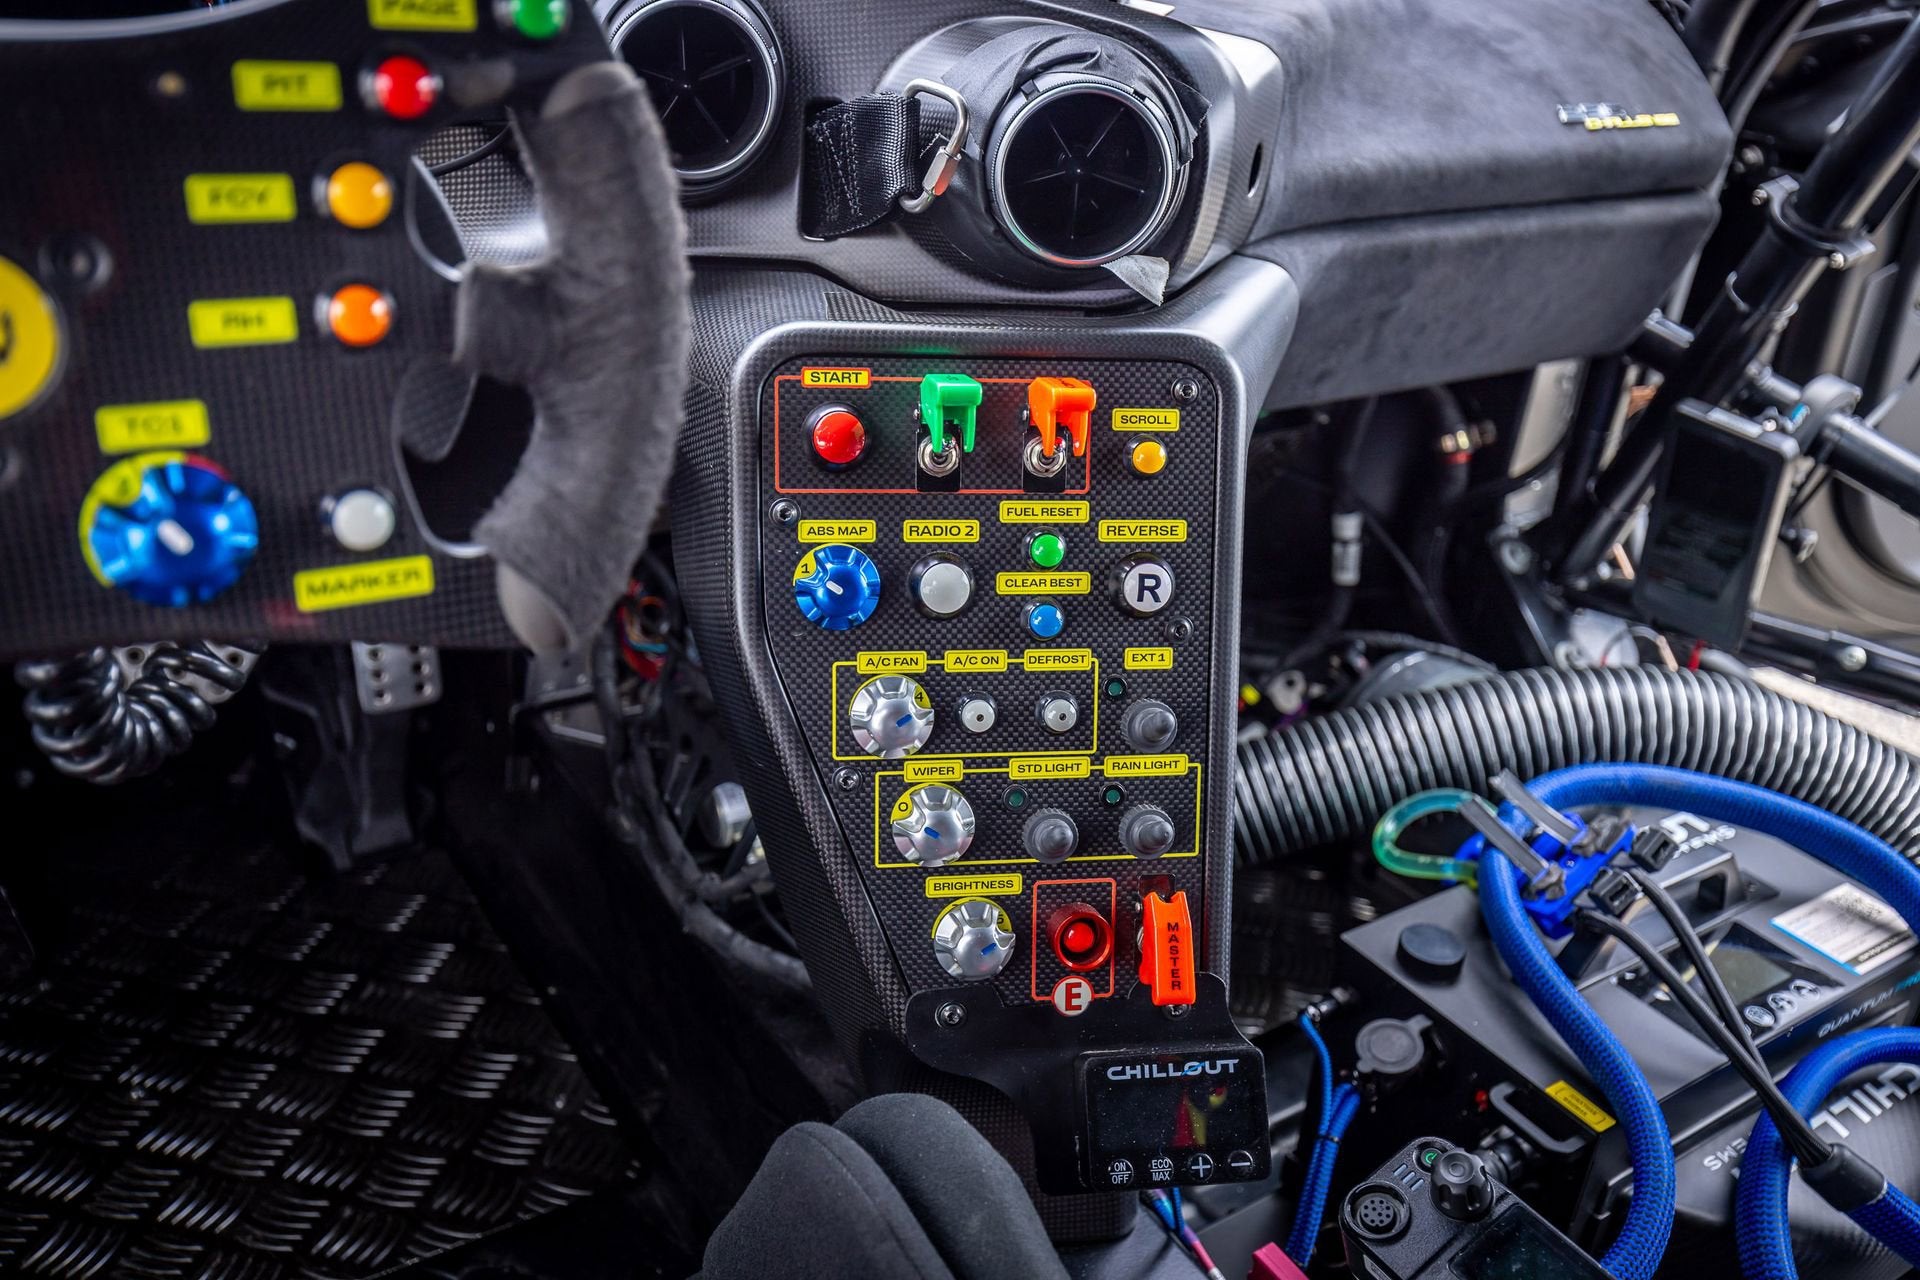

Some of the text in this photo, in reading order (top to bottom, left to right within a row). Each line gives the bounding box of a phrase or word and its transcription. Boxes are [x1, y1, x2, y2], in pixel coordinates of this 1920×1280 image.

[262, 73, 308, 93] PIT
[810, 371, 862, 383] START
[1120, 413, 1171, 425] SCROLL
[1006, 506, 1082, 517] FUEL RESET
[806, 525, 868, 537] ABS MAP
[909, 525, 975, 537] RADIO 2
[1106, 525, 1179, 537] REVERSE
[800, 562, 810, 574] 1
[306, 567, 421, 599] MARKER
[1004, 577, 1084, 589] CLEAR BEST
[1136, 573, 1162, 603] R
[865, 656, 919, 668] A/C FAN
[953, 655, 1000, 667] A/C ON
[1028, 654, 1088, 666] DEFROST
[1131, 652, 1167, 663] EXT 1
[915, 692, 924, 702] 4
[1017, 761, 1083, 774] STD LIGHT
[1111, 758, 1181, 771] RAIN LIGHT
[912, 765, 956, 777] WIPER
[933, 879, 1014, 892] BRIGHTNESS
[1167, 922, 1182, 991] MASTER
[1064, 982, 1083, 1012] E
[1817, 987, 1895, 1039] QUANTUM
[1106, 1058, 1240, 1081] CHILLOUT
[1114, 1161, 1127, 1172] ON
[1151, 1158, 1170, 1169] ECO
[1111, 1173, 1129, 1185] OFF
[1152, 1171, 1171, 1182] MAX
